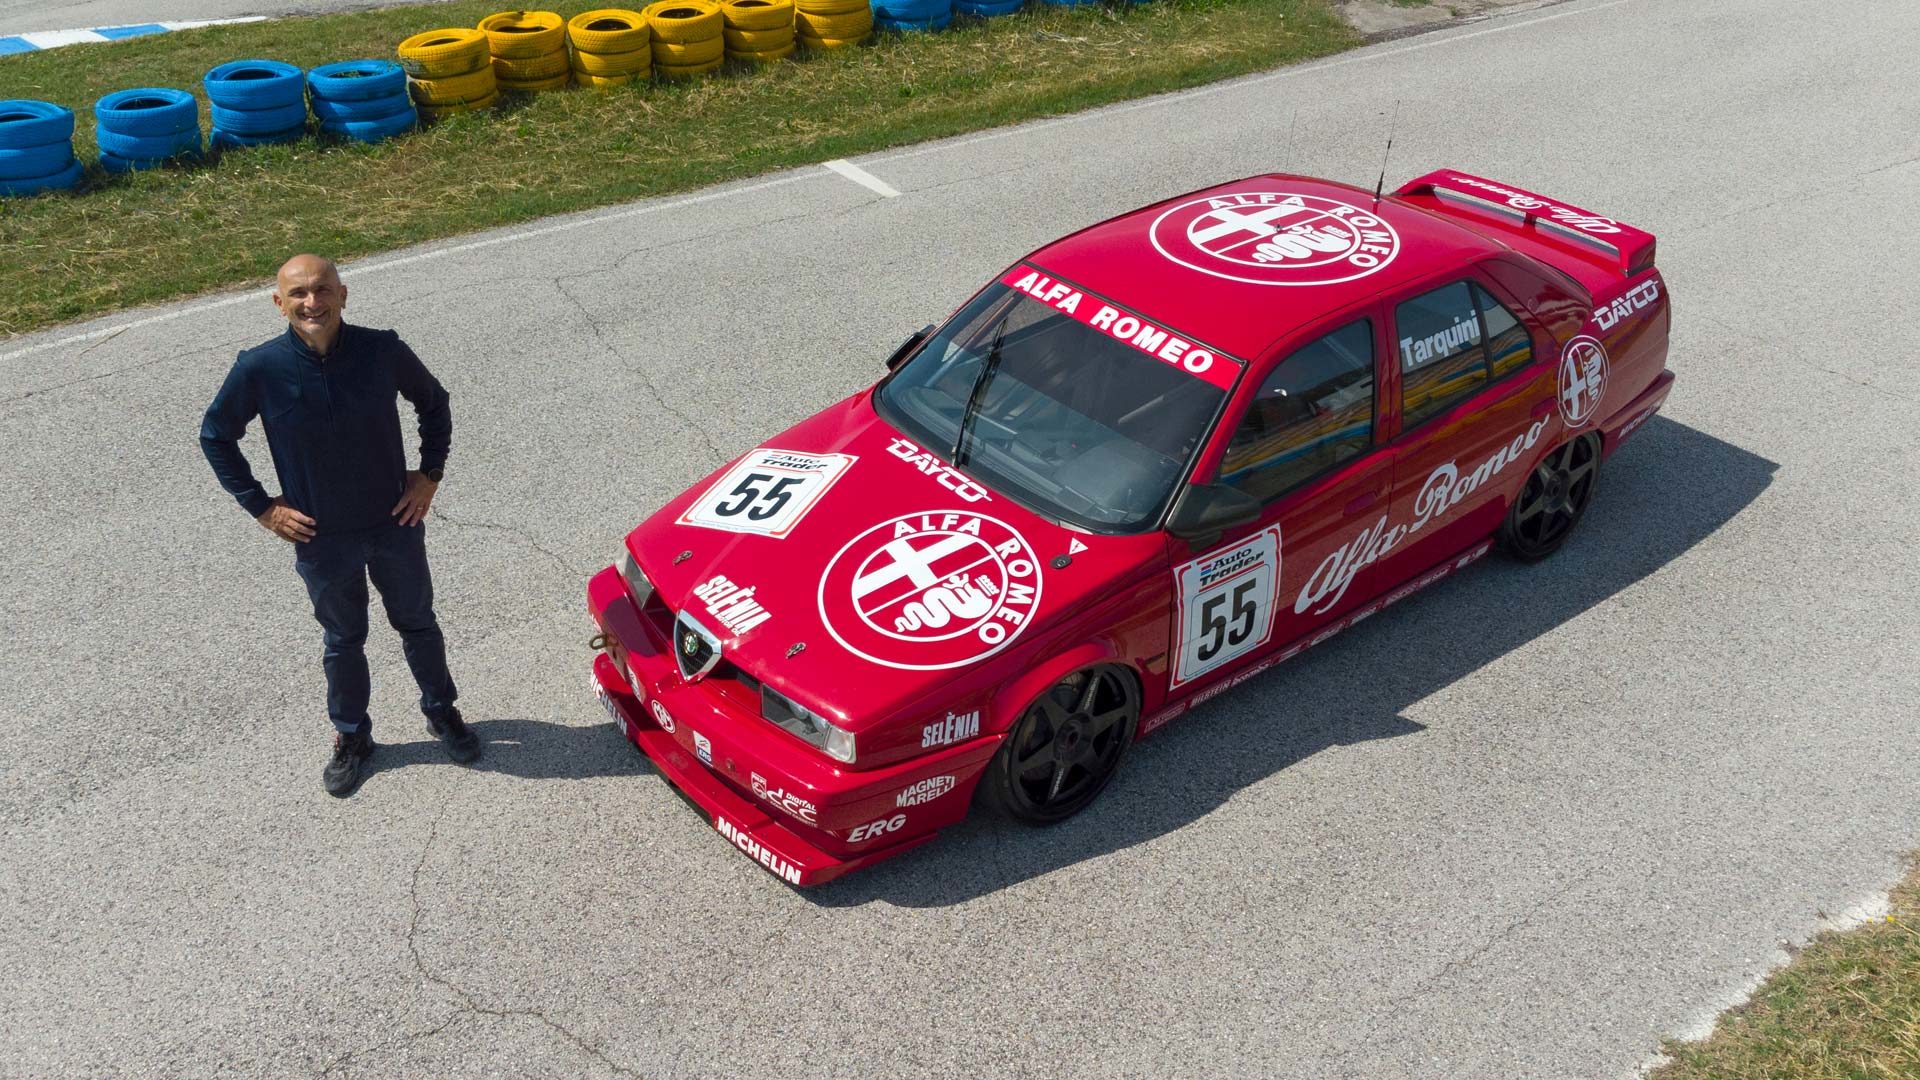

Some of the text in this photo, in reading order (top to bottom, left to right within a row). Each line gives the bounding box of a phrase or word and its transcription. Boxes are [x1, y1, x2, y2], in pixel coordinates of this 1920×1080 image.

[1208, 194, 1392, 267] ALFA ROMEO
[1013, 271, 1214, 374] ALFA ROMEO
[1591, 279, 1660, 331] DAYCO
[1400, 309, 1481, 368] Tarquini
[762, 459, 829, 469] Trader
[780, 455, 821, 464] Auto
[886, 437, 993, 502] DAYCO
[715, 473, 805, 521] 55
[1294, 413, 1550, 616] Alfa Romeo
[894, 514, 1036, 645] ALFA ROMEO
[1200, 551, 1264, 587] Trader
[1210, 549, 1252, 571] Auto
[693, 574, 772, 634] SELÈNIA
[1198, 577, 1257, 661] 55
[921, 710, 980, 748] SELÈNIA
[698, 747, 713, 762] ERG
[786, 792, 817, 811] DIGITAL
[896, 775, 955, 802] MAGNETI
[896, 781, 955, 808] MARELLI
[717, 815, 802, 885] MICHELIN
[847, 814, 907, 843] ERG
